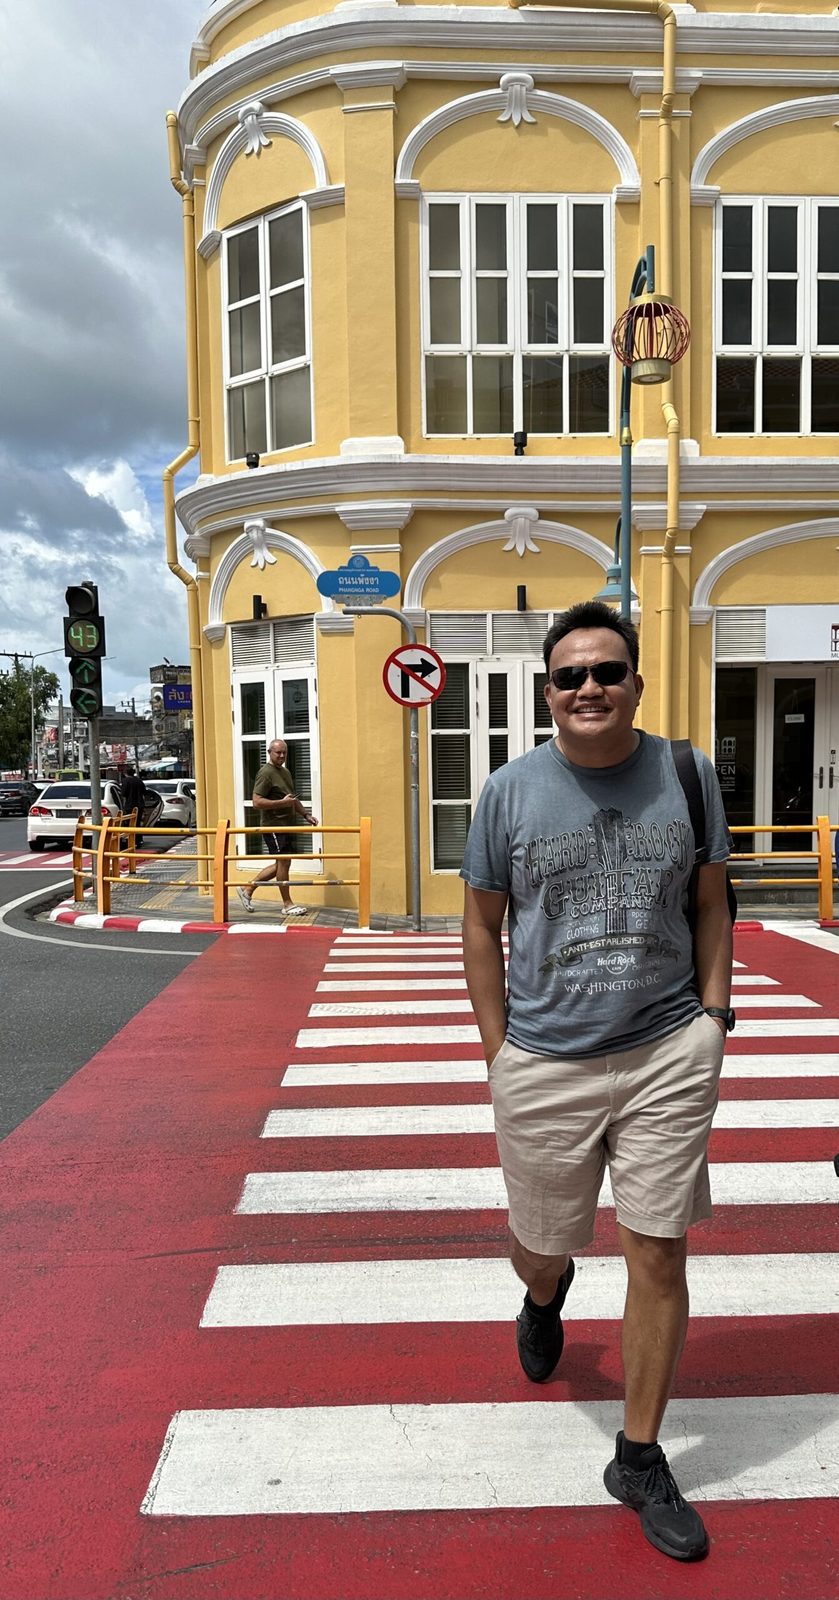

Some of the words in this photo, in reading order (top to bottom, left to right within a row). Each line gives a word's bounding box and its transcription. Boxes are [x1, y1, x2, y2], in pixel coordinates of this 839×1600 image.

[338, 573, 379, 585] ถนนพังงา
[70, 625, 97, 648] 43
[715, 765, 736, 775] PEN
[524, 828, 588, 888] HARD
[631, 818, 689, 871] ROCK
[541, 867, 674, 919] GUITAR
[570, 894, 652, 918] COMPANY
[631, 911, 649, 919] ROCK
[566, 923, 599, 940] CLOTHING
[597, 956, 616, 966] Hard
[617, 954, 636, 966] Rock
